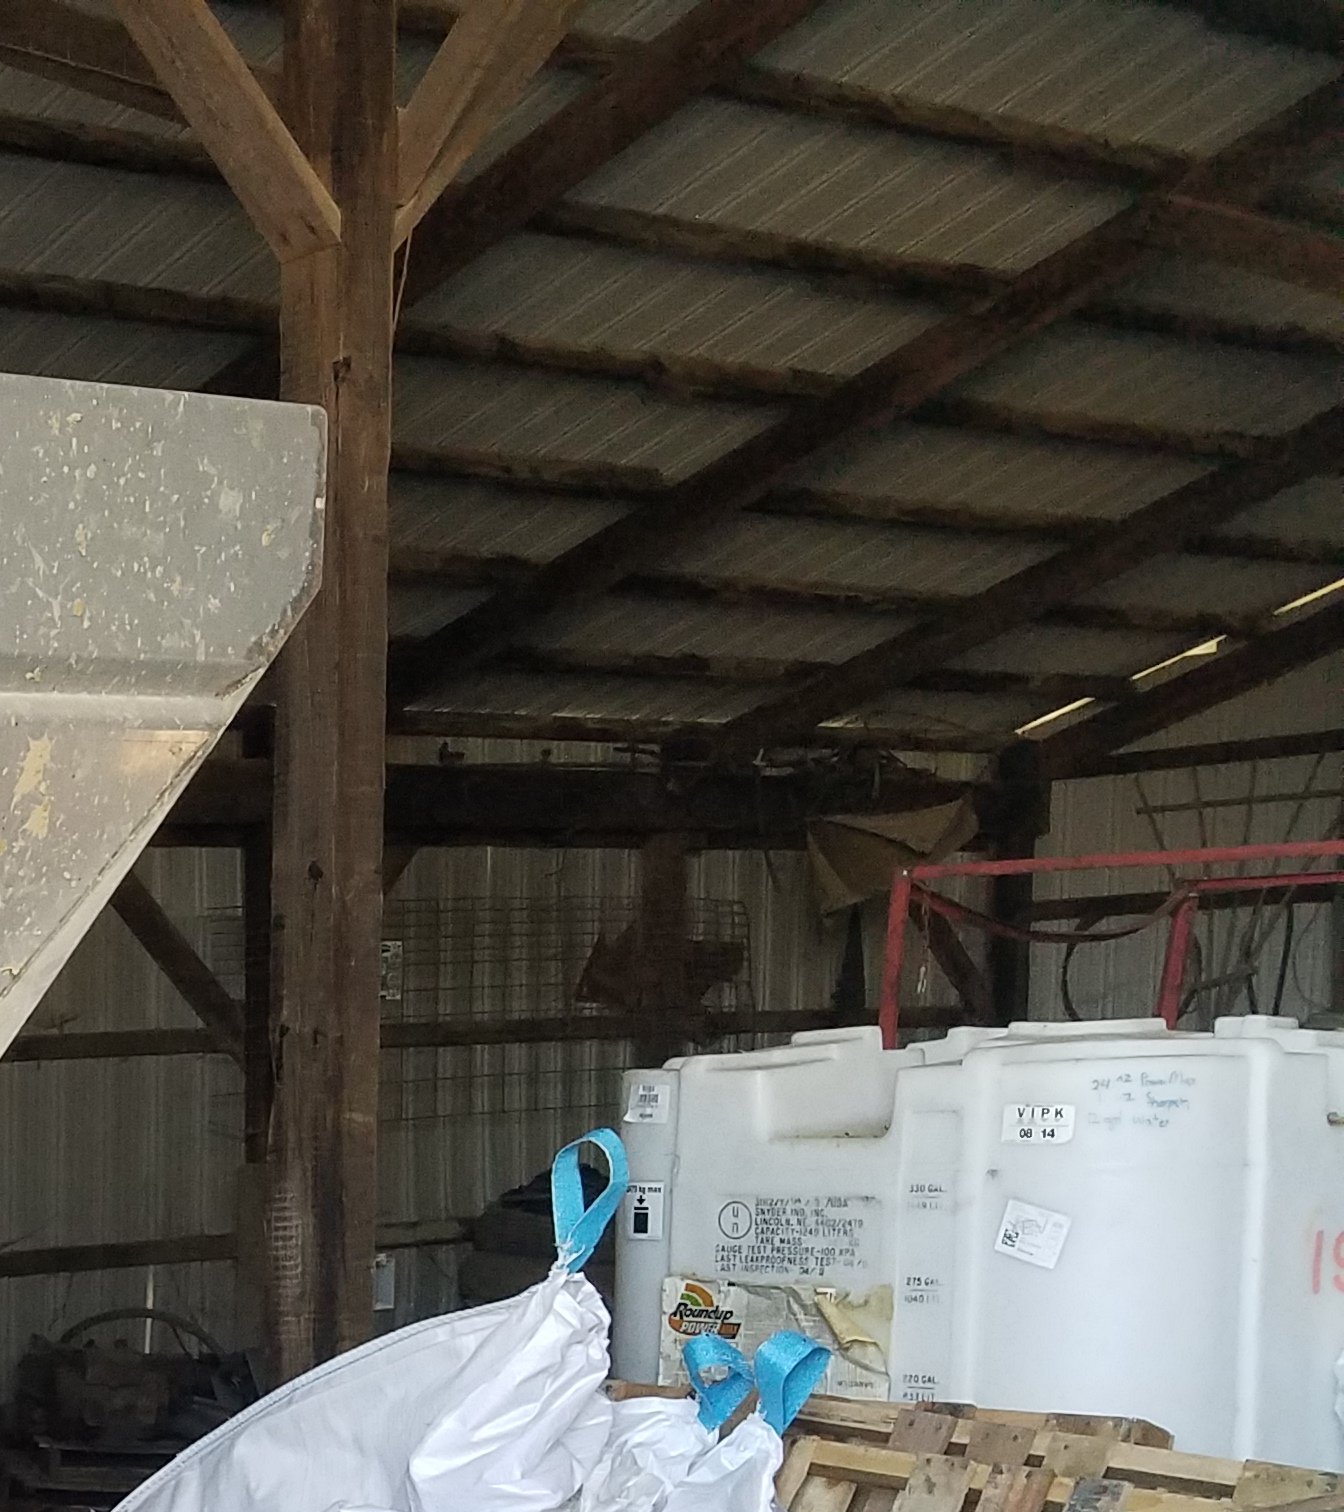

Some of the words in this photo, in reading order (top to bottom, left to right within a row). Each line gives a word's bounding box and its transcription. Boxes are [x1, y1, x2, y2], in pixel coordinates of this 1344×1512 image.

[1019, 1128, 1032, 1138] 08
[1041, 1128, 1055, 1138] 14
[747, 1245, 767, 1254] TEST
[673, 1302, 734, 1322] Roundup
